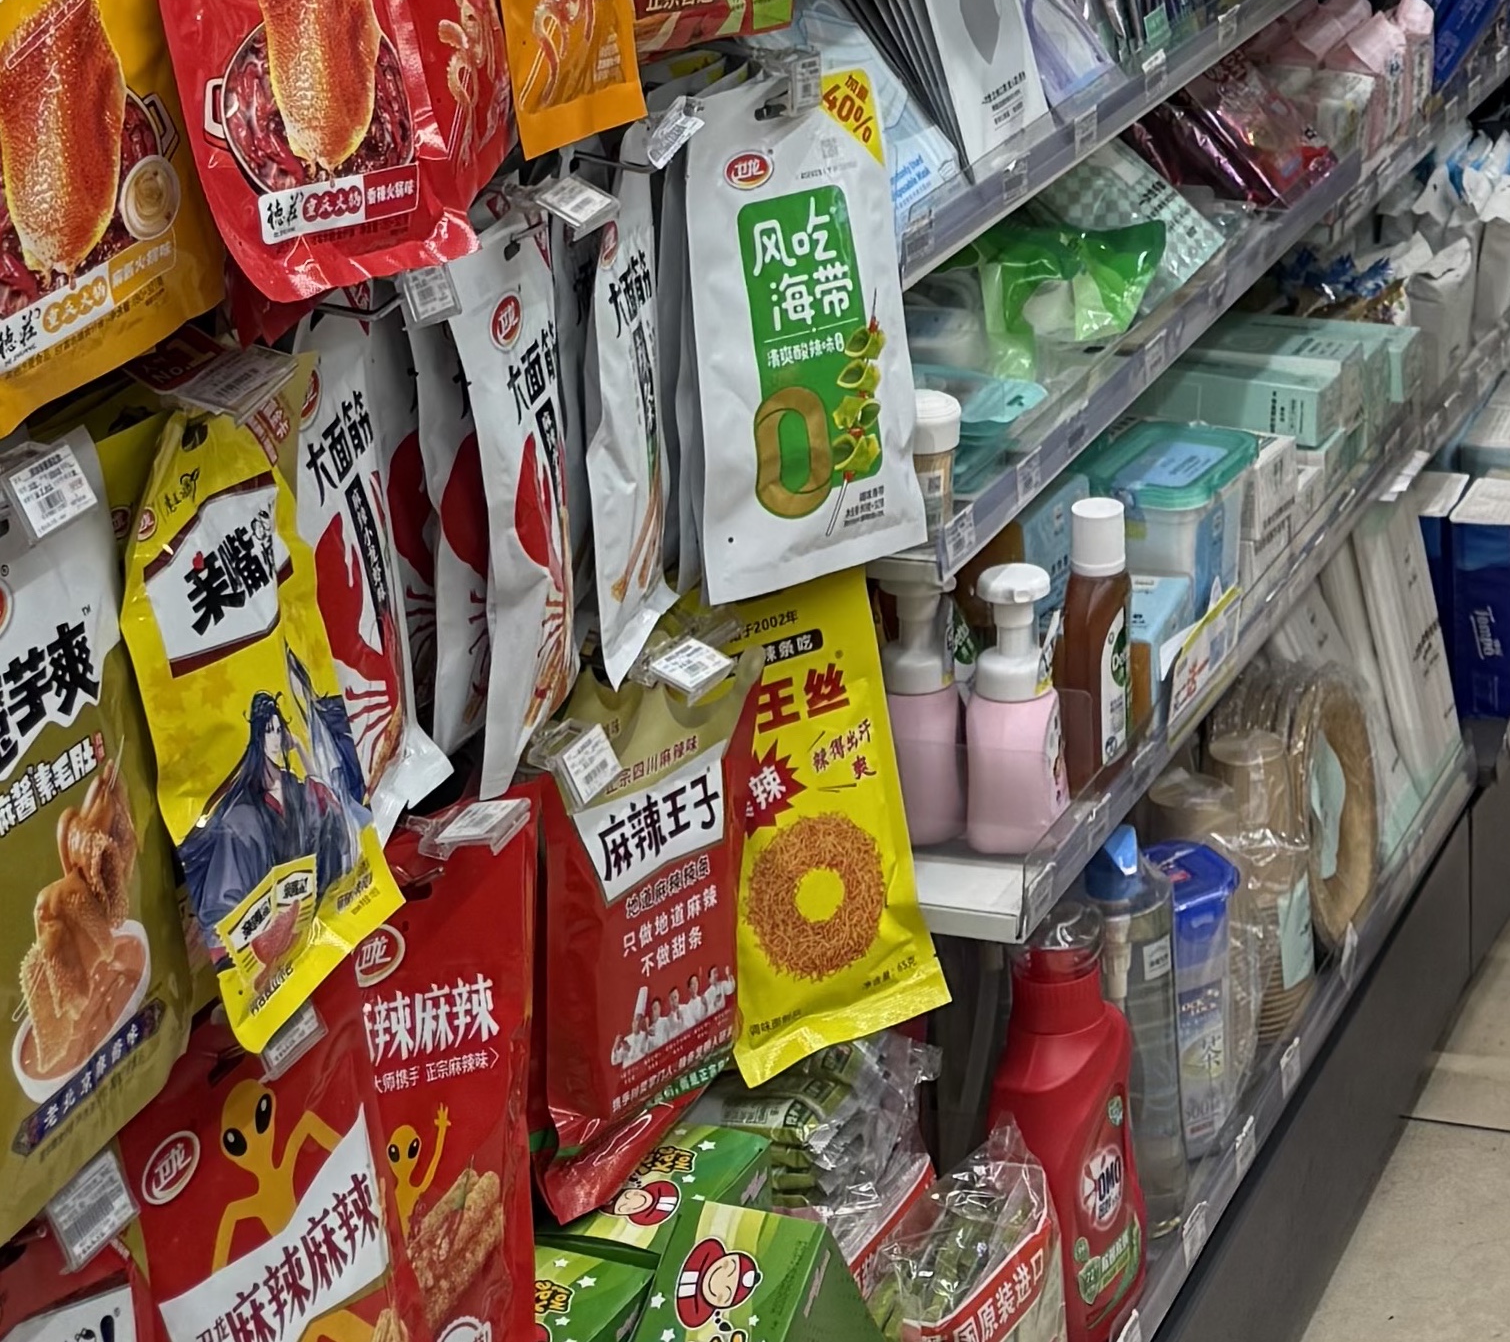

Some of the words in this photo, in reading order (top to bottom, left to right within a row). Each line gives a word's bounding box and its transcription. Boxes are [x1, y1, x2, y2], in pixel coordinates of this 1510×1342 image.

[821, 87, 872, 145] 40%
[728, 157, 769, 182] 卫龙
[751, 195, 837, 277] 风吃
[770, 260, 855, 334] 海带
[305, 389, 376, 508] 大面筋
[0, 619, 101, 764] 芋爽
[811, 718, 873, 774] 辣得出汗
[599, 774, 722, 883] 麻辣王子
[621, 887, 720, 959] 只做地道麻辣
[640, 926, 704, 978] 不做甜条
[364, 973, 500, 1065] 辣麻辣
[425, 1051, 490, 1082] 正宗麻辣味
[153, 1145, 191, 1189] 卫龙
[1098, 1155, 1122, 1202] OMO
